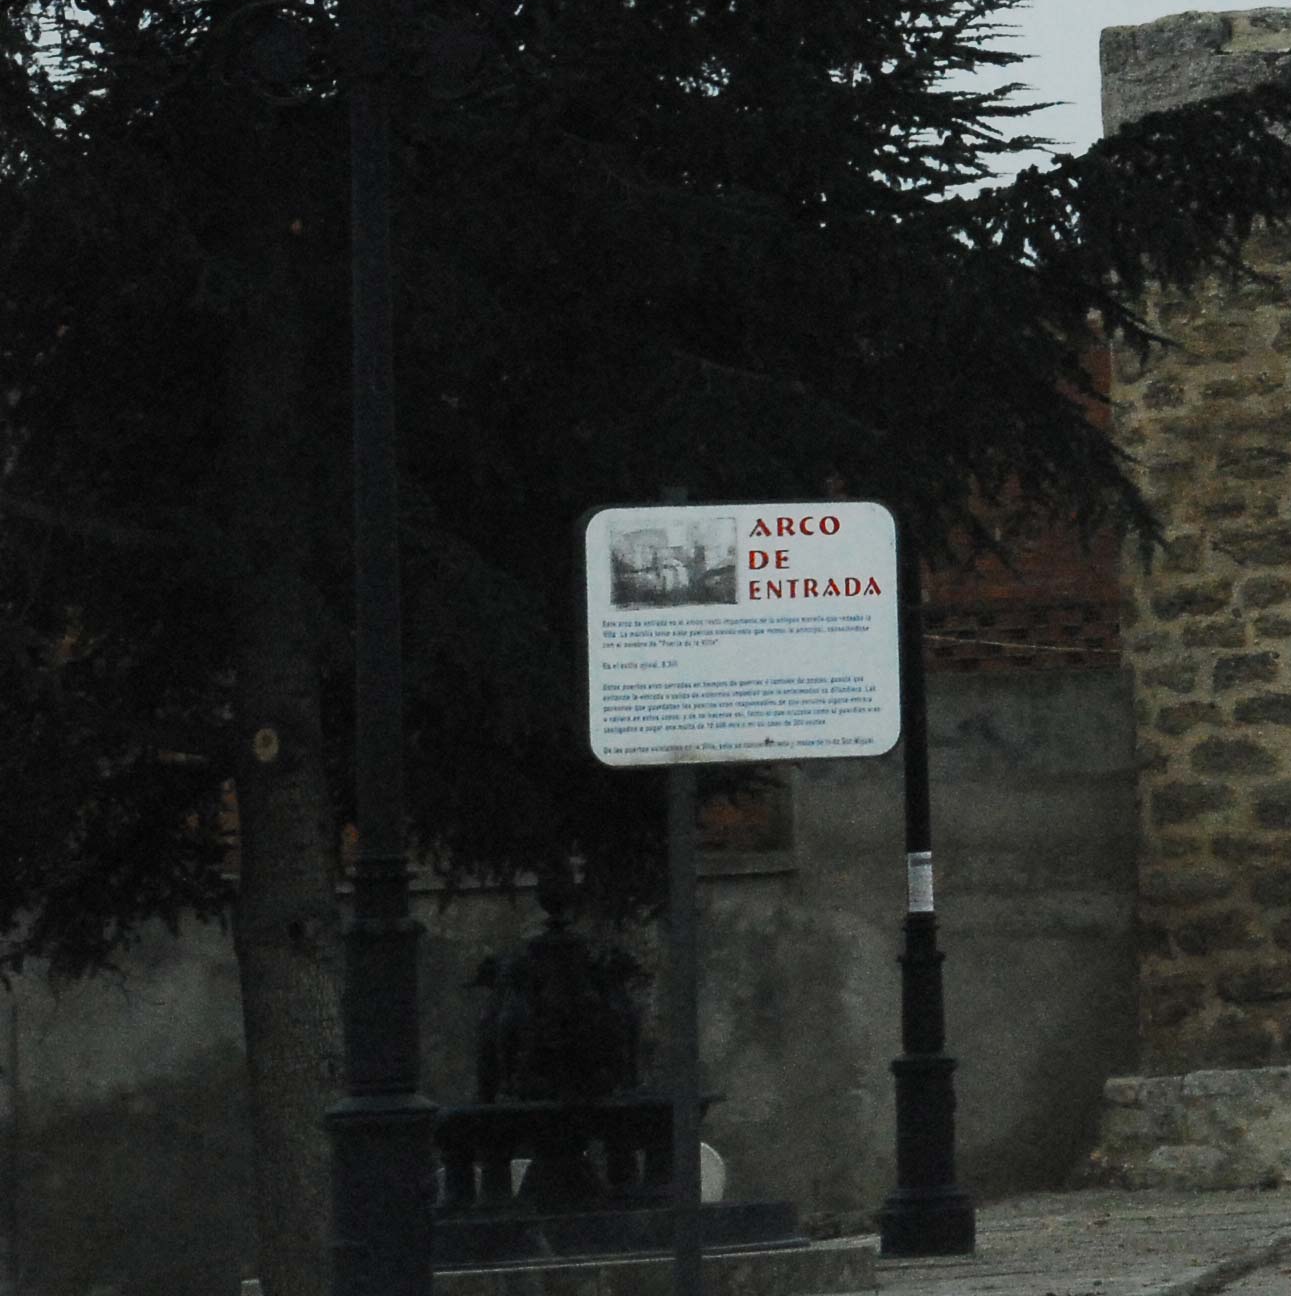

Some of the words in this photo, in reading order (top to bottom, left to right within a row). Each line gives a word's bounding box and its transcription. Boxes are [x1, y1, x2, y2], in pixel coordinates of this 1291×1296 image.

[749, 515, 841, 538] ARCO
[748, 549, 792, 571] DE
[748, 576, 883, 601] ENTRADA
